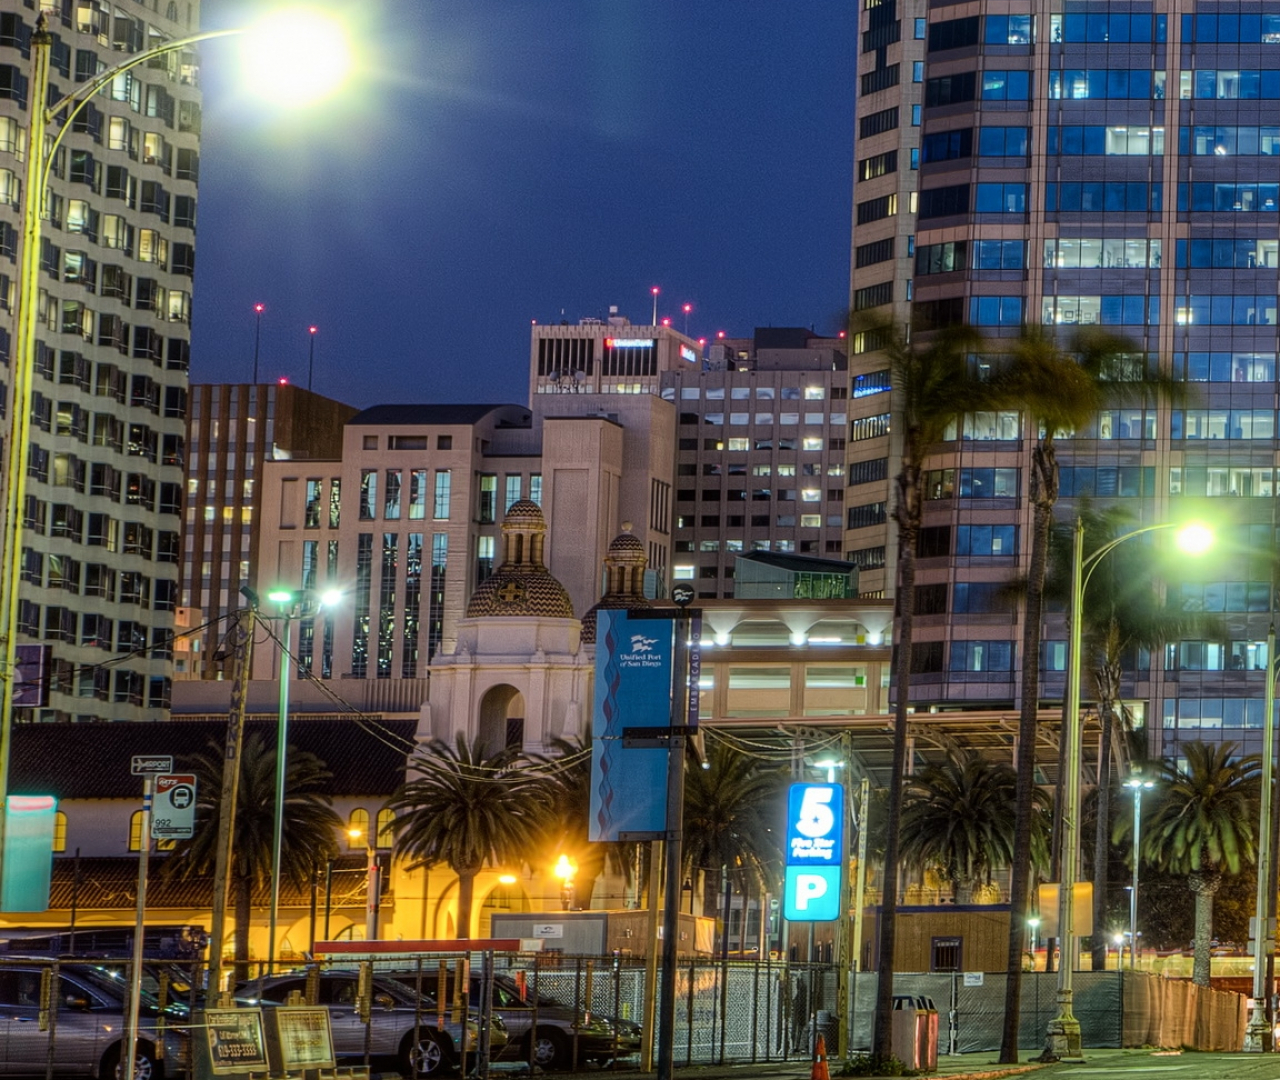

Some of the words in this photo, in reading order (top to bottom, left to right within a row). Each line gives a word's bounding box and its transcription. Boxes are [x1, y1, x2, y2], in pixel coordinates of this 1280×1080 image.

[620, 653, 646, 661] Unified
[628, 660, 641, 668] San
[641, 660, 662, 668] Diego
[796, 787, 834, 838] 5
[154, 819, 172, 828] 992
[795, 874, 828, 911] P
